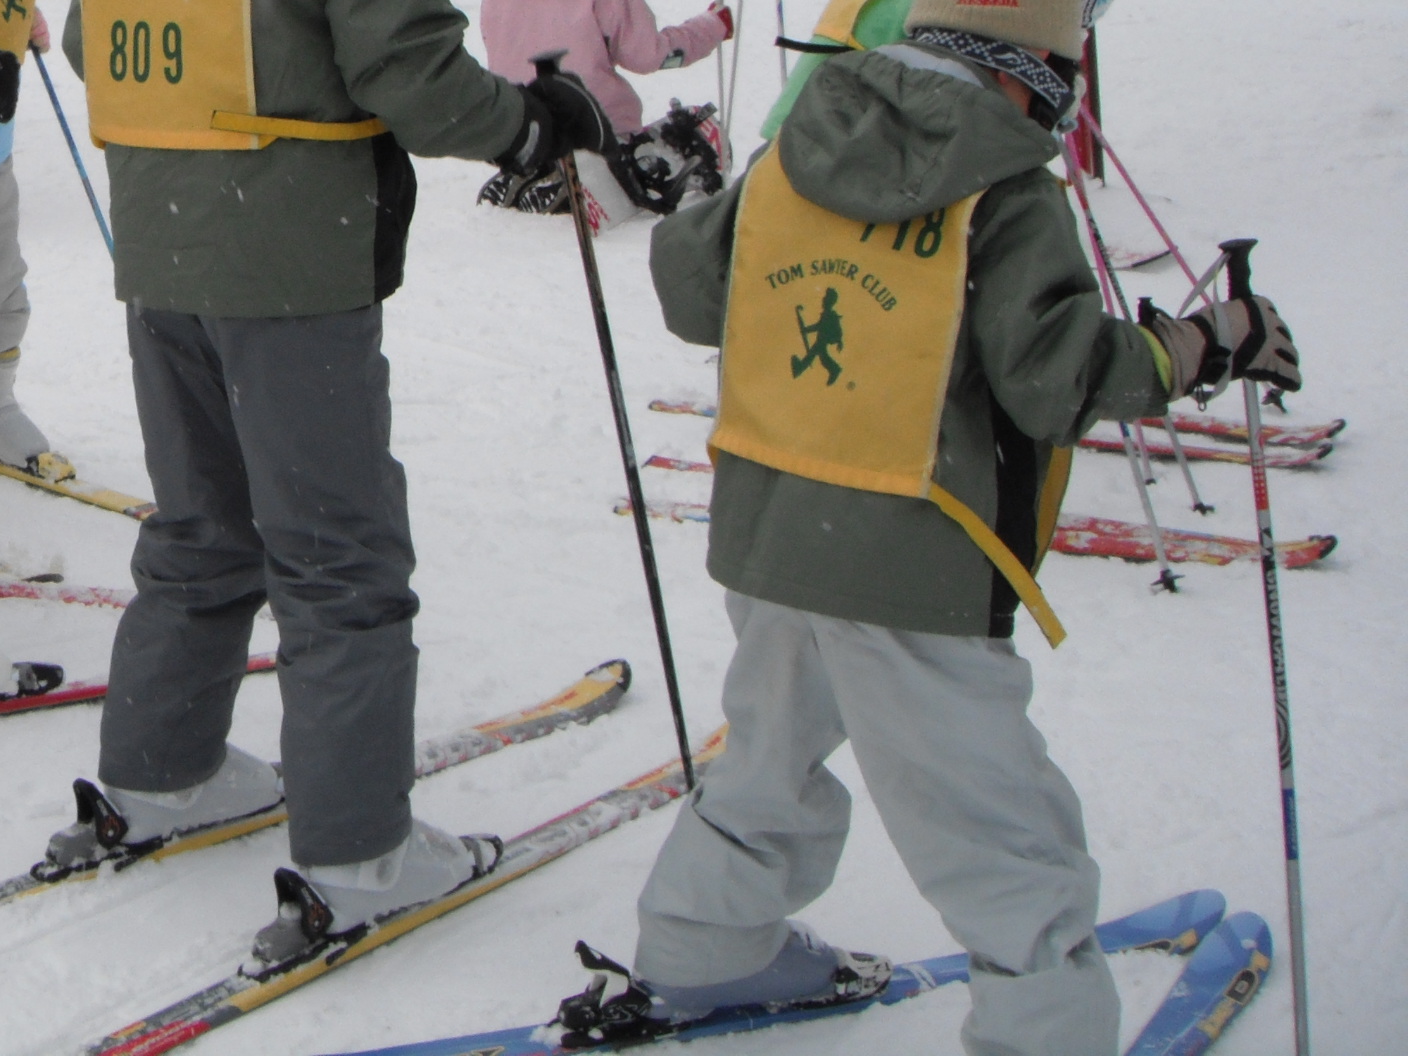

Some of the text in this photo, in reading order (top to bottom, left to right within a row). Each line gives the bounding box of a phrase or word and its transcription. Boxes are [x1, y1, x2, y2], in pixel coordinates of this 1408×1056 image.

[109, 19, 184, 85] 809
[765, 258, 898, 312] TOM SAWYER CLUB
